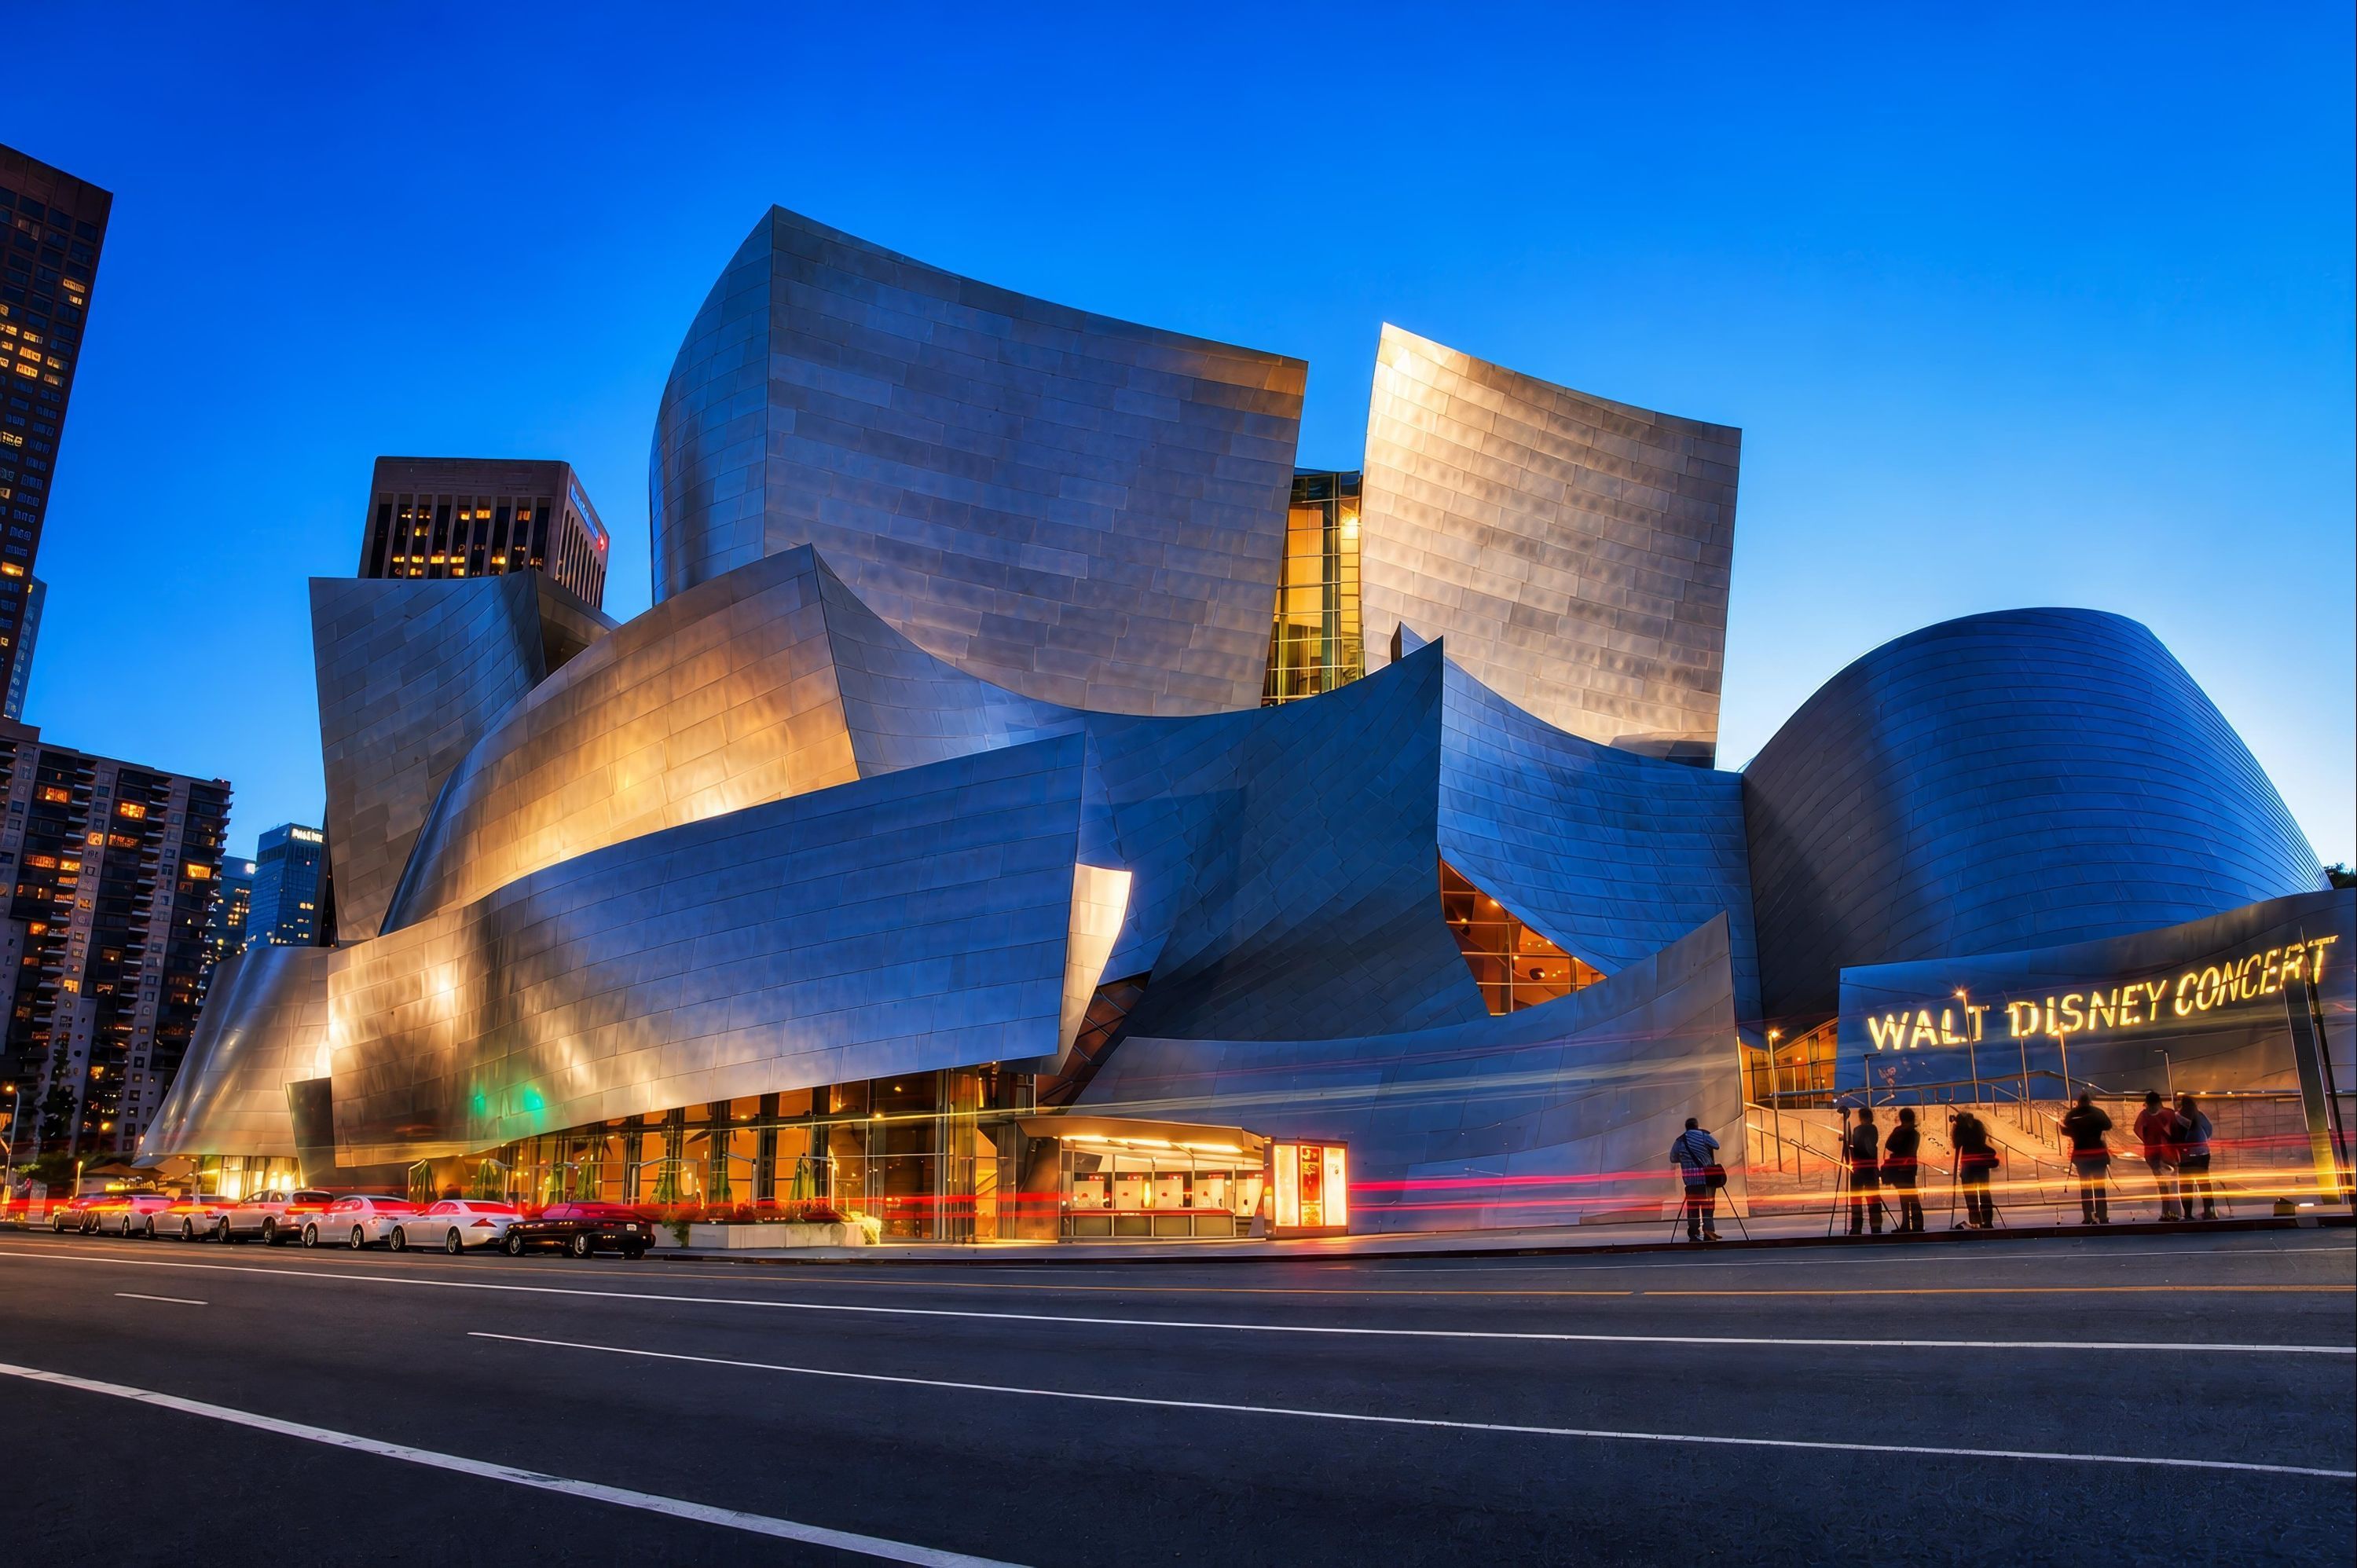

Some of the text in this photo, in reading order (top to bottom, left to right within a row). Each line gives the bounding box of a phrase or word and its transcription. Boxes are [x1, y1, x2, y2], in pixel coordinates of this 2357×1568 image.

[1867, 935, 2339, 1051] WALT DISNEY CONCERT
